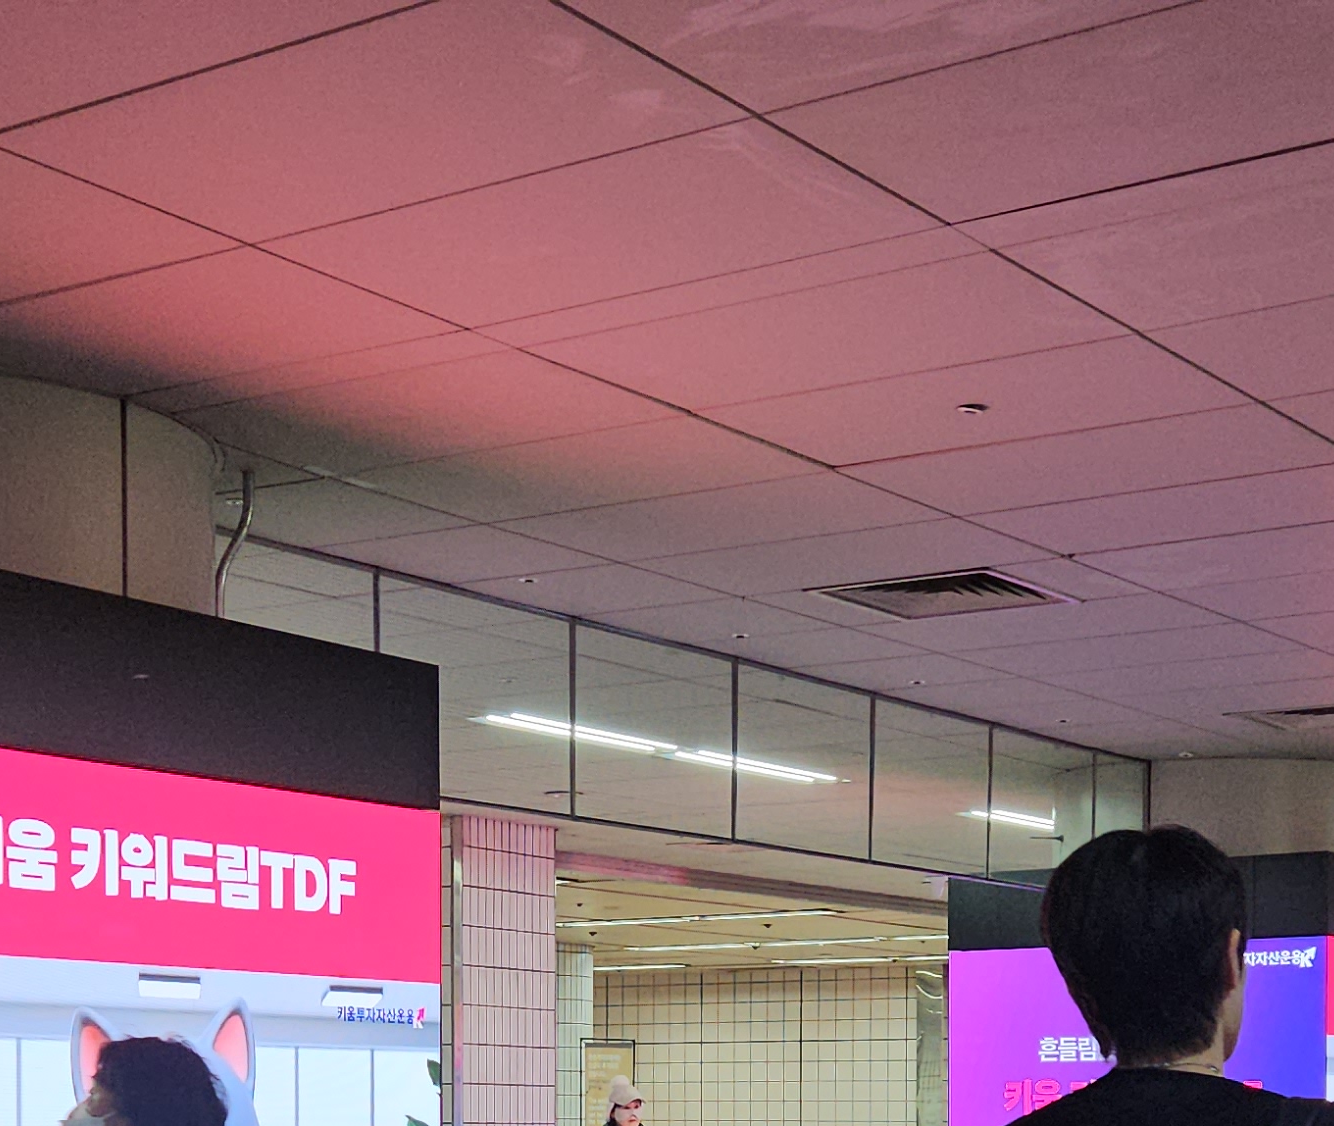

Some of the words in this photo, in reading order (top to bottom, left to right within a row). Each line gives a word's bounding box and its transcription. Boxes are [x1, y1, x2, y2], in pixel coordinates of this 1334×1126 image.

[71, 829, 357, 915] 키워드림TDF
[1244, 949, 1301, 966] 자자산운용
[337, 1006, 414, 1025] 키움투자자산운용
[1038, 1036, 1107, 1063] 흔들림
